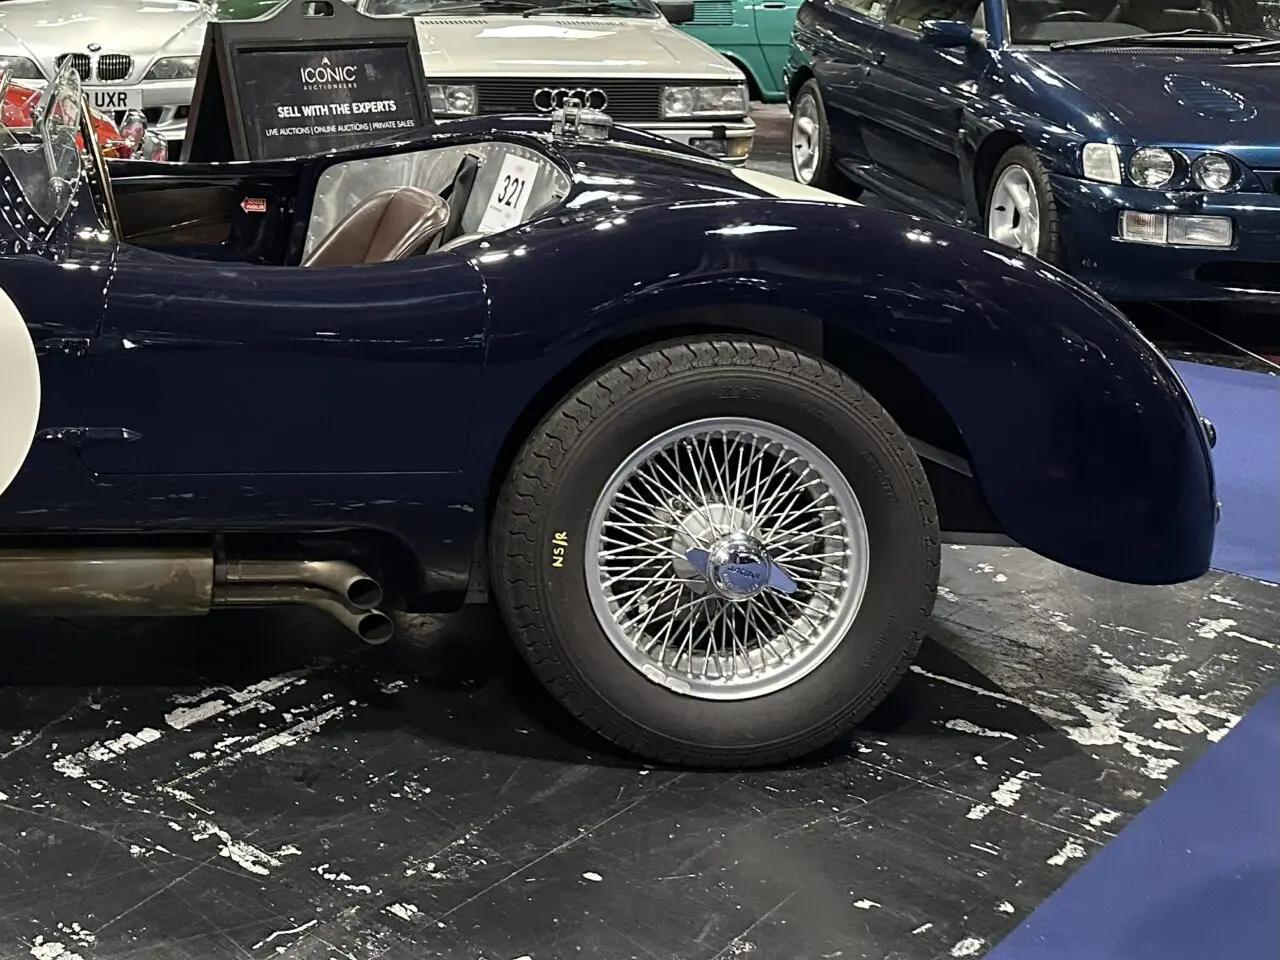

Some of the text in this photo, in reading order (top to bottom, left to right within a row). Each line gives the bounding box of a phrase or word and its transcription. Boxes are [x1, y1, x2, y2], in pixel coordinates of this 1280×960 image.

[300, 65, 357, 83] ICONIC
[303, 82, 358, 91] AUCTIONEERS
[94, 91, 128, 108] UXR
[277, 100, 397, 118] SELL WITH THE EXPERTS
[266, 119, 415, 137] LIVE AUCTIONS ONLINE AUCTIONS PRIVATE SALES
[497, 174, 526, 210] 321
[552, 531, 568, 567] NS/R
